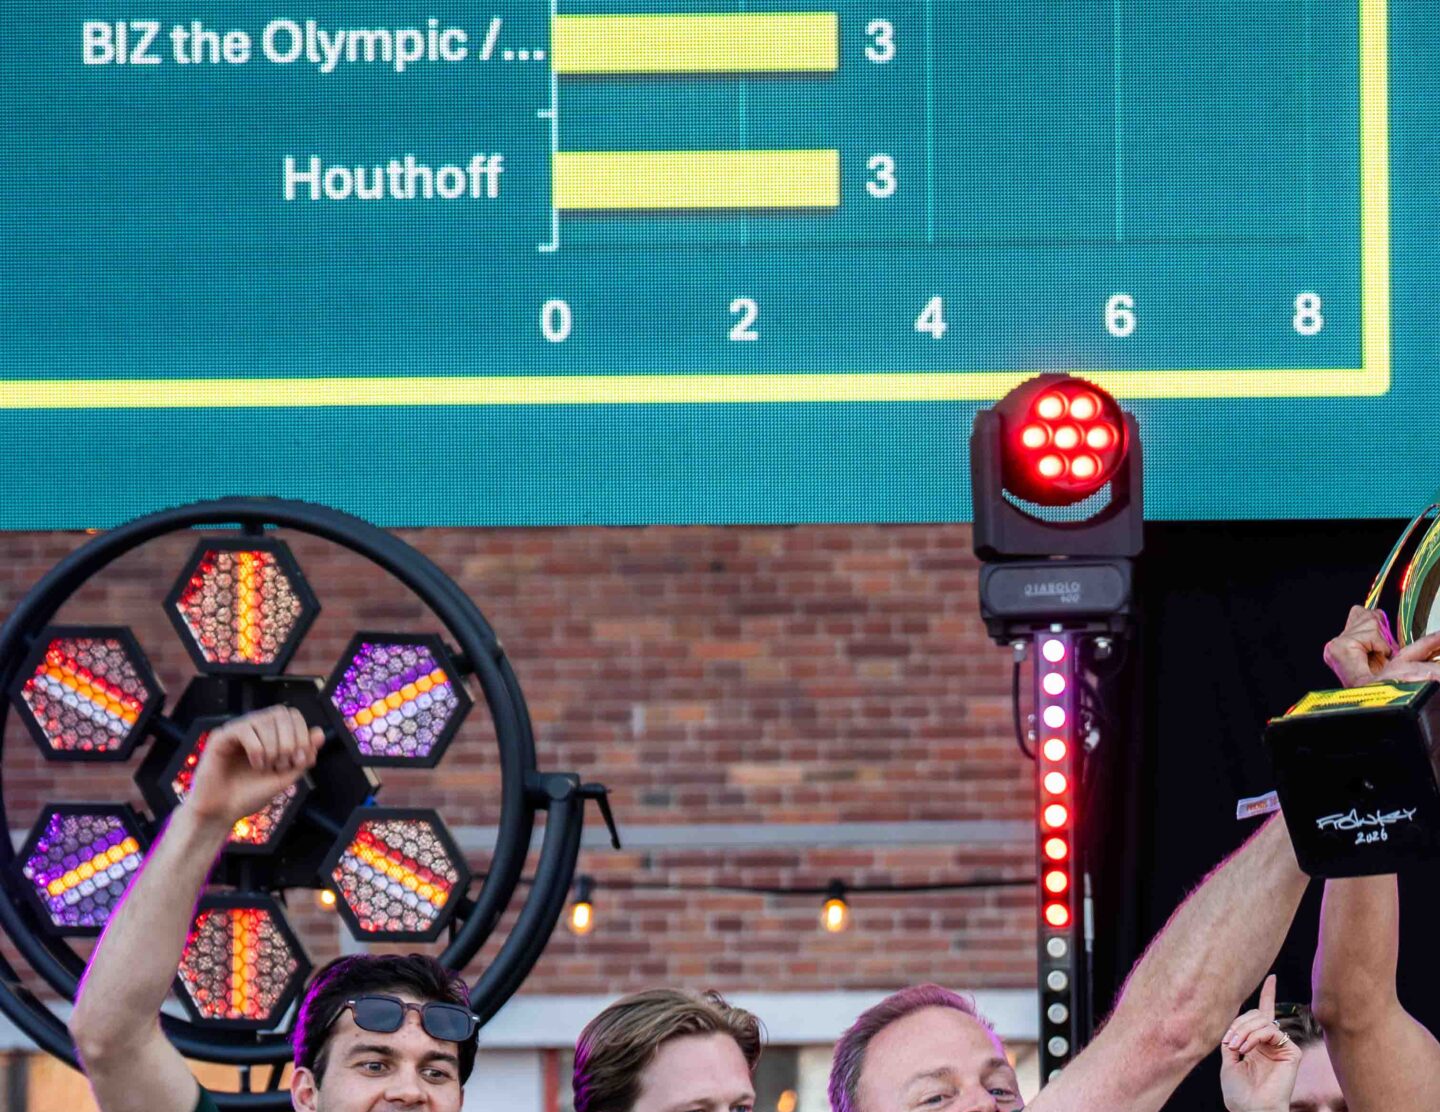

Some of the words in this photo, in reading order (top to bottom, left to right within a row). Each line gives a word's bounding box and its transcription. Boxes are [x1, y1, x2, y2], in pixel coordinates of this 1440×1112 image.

[82, 22, 162, 64] BIZ
[170, 21, 251, 64] the
[262, 18, 468, 74] Olympic
[864, 19, 896, 63] 3
[284, 153, 504, 200] Houthoff
[866, 152, 898, 198] 3
[540, 299, 572, 342] 0
[729, 297, 759, 341] 2
[914, 294, 947, 340] 4
[1103, 291, 1136, 337] 6
[1293, 291, 1324, 336] 8
[1355, 828, 1387, 845] 2026
